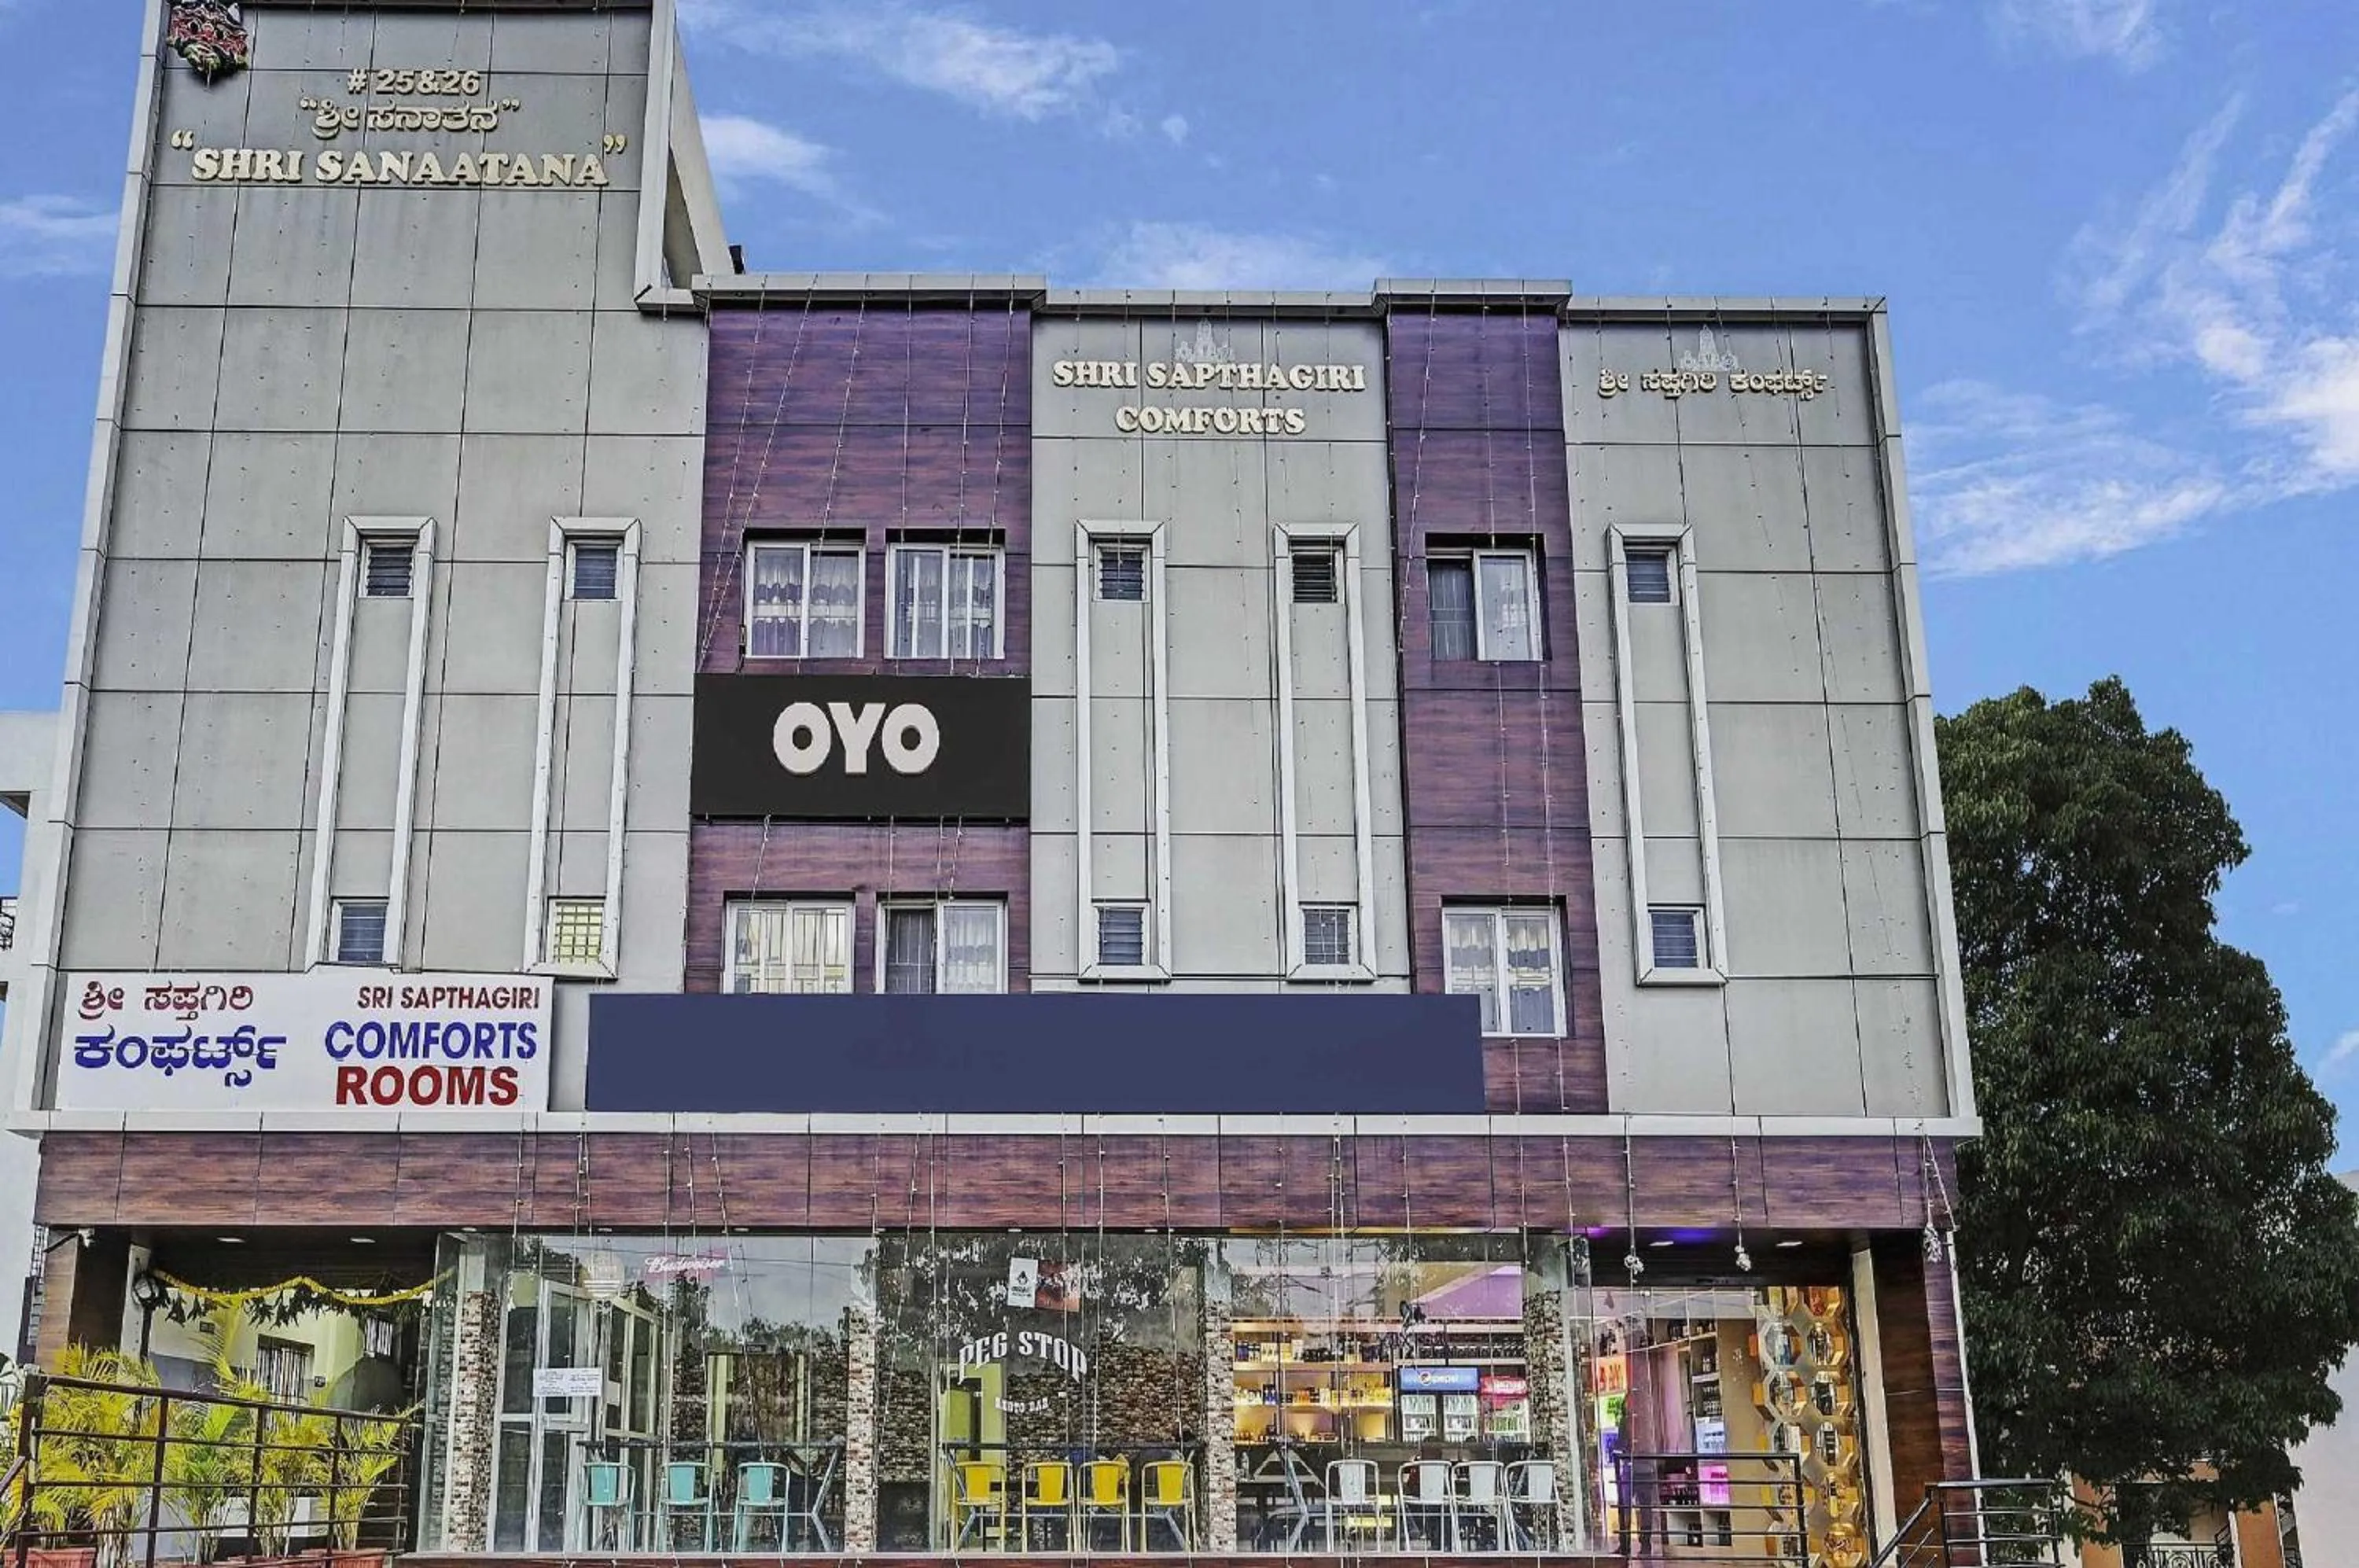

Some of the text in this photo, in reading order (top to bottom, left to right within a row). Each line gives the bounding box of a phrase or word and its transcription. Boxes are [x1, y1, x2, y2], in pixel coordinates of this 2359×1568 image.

[375, 68, 481, 95] 25&26
[1053, 360, 1366, 392] SHRI SAPTHAGIRI
[1598, 368, 1629, 399] ಶ್ರೀ
[1115, 406, 1306, 434] COMFORTS
[773, 702, 940, 775] OYO
[79, 980, 255, 1021] ಶ್ರೀ ಸಪ್ತಗಿರಿ
[358, 986, 540, 1009] SRI SAPTHAGIRI
[325, 1021, 538, 1059] COMFORTS
[336, 1066, 519, 1106] ROOMS
[645, 1257, 726, 1274] Budweiser
[957, 1331, 1087, 1386] PEG STOP
